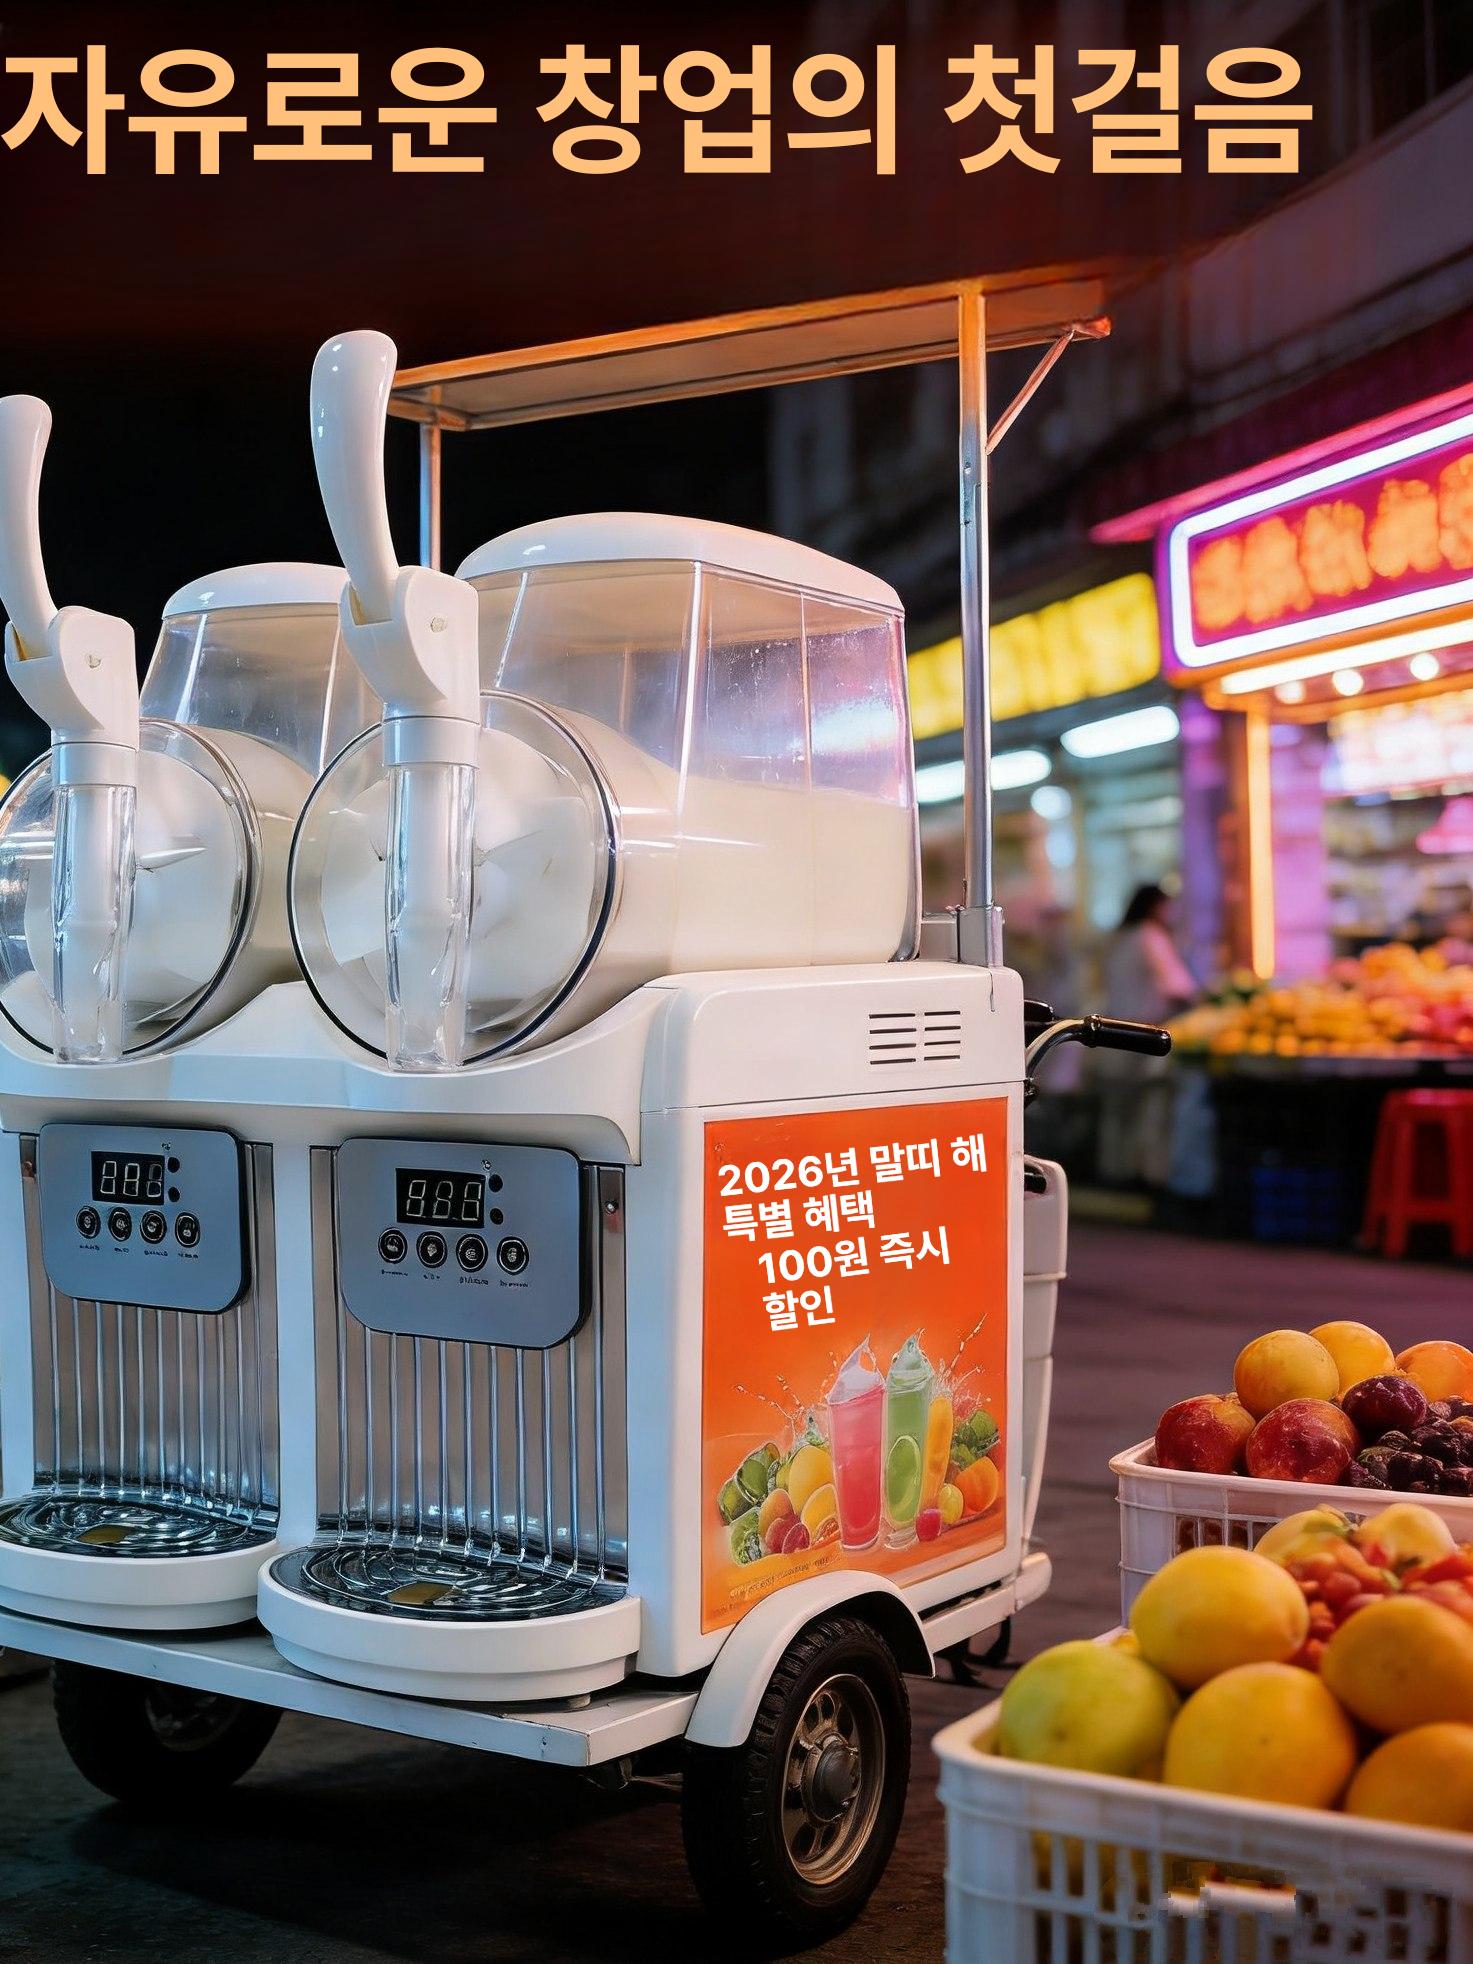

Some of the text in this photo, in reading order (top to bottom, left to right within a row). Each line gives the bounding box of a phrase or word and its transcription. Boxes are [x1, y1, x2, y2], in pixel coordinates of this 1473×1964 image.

[718, 1133, 987, 1197] 2026년 말띠 해
[722, 1189, 875, 1242] 특별 혜택
[758, 1225, 950, 1284] 100원 즉시
[762, 1285, 836, 1332] 할인
